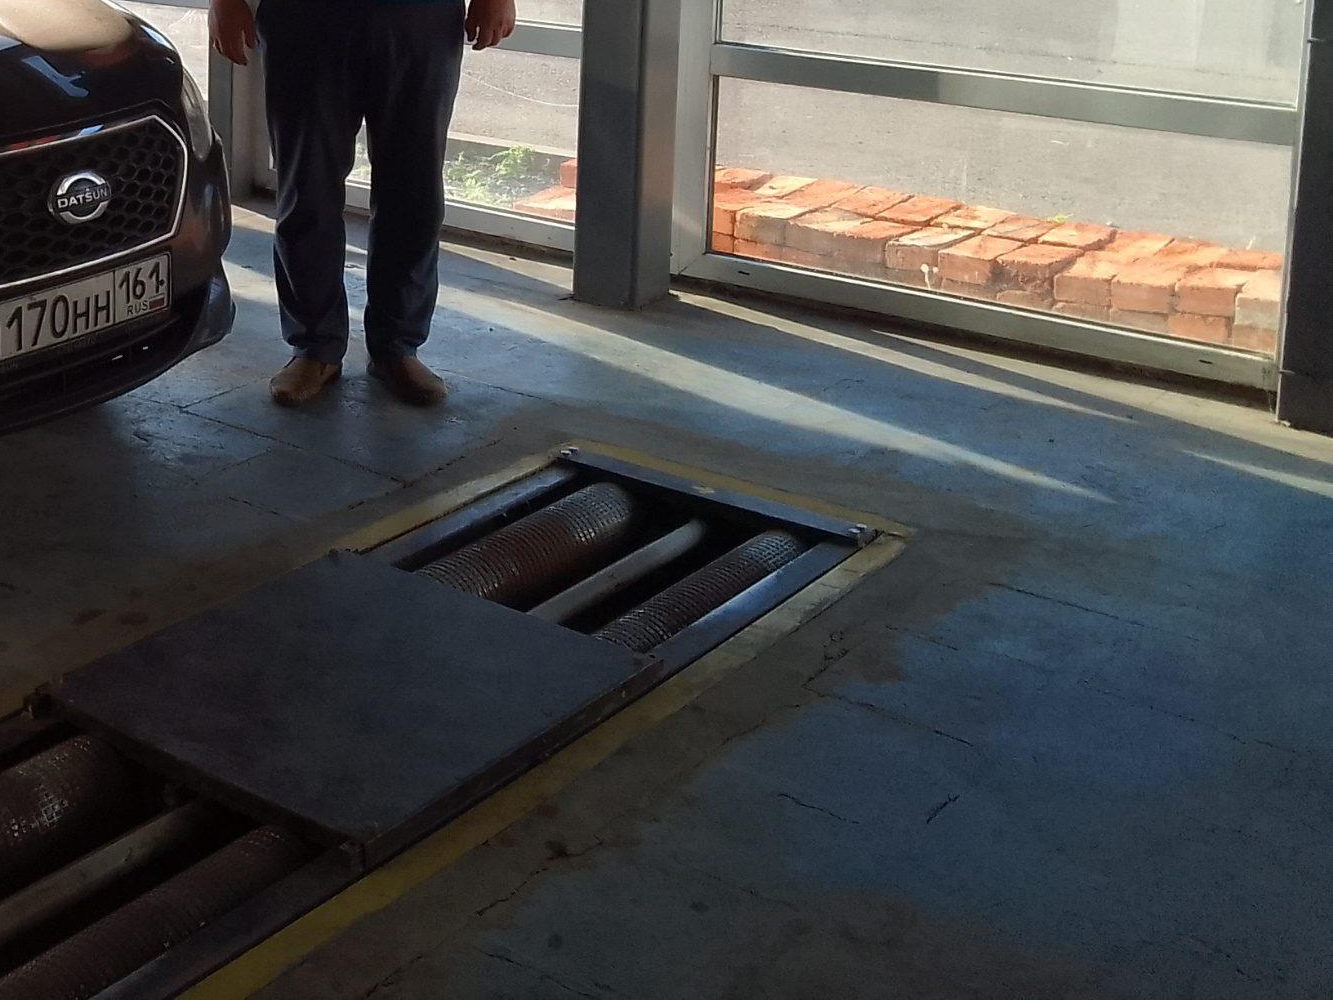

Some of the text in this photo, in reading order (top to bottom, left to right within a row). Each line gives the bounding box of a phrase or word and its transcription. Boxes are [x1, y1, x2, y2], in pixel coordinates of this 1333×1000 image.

[56, 187, 108, 209] DATSUN
[118, 261, 160, 304] 161
[127, 299, 149, 315] RUS
